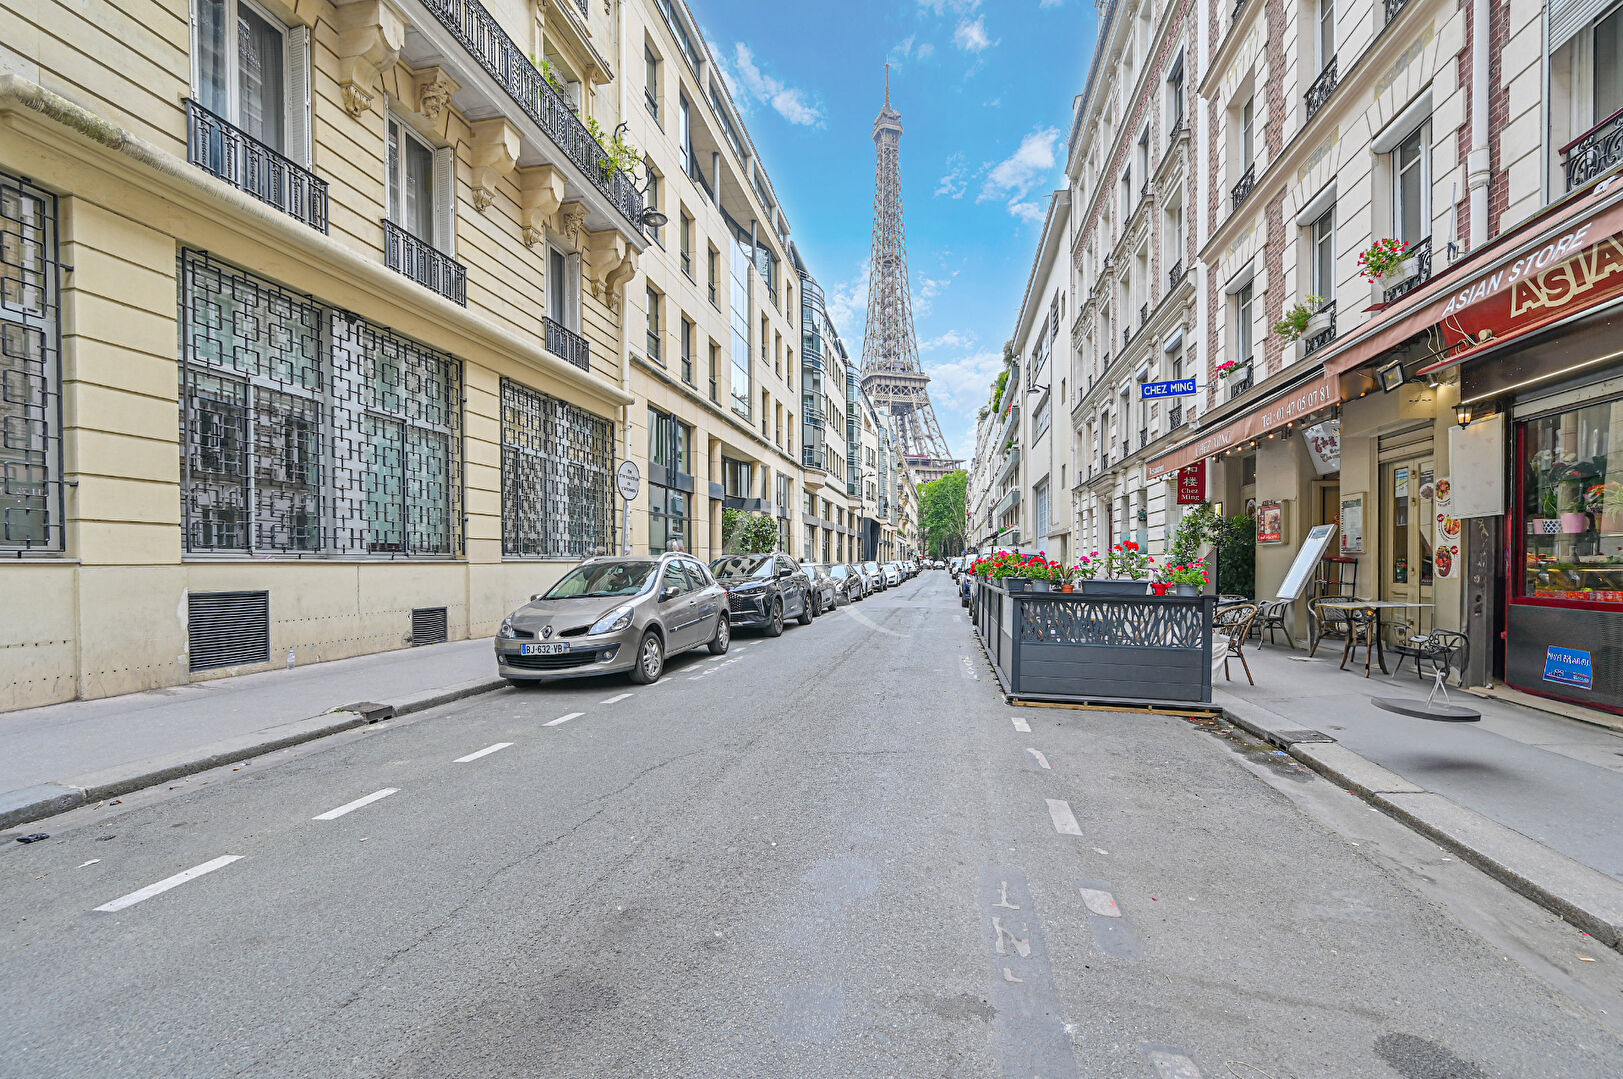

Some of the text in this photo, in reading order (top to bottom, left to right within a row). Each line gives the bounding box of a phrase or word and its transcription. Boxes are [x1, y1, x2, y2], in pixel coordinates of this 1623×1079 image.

[1441, 222, 1592, 316] ASIAN STORE
[1144, 381, 1194, 396] CHEZ MING
[1277, 406, 1285, 420] 01
[1287, 402, 1295, 416] 47
[1308, 390, 1318, 407] 07
[1319, 385, 1330, 401] 81
